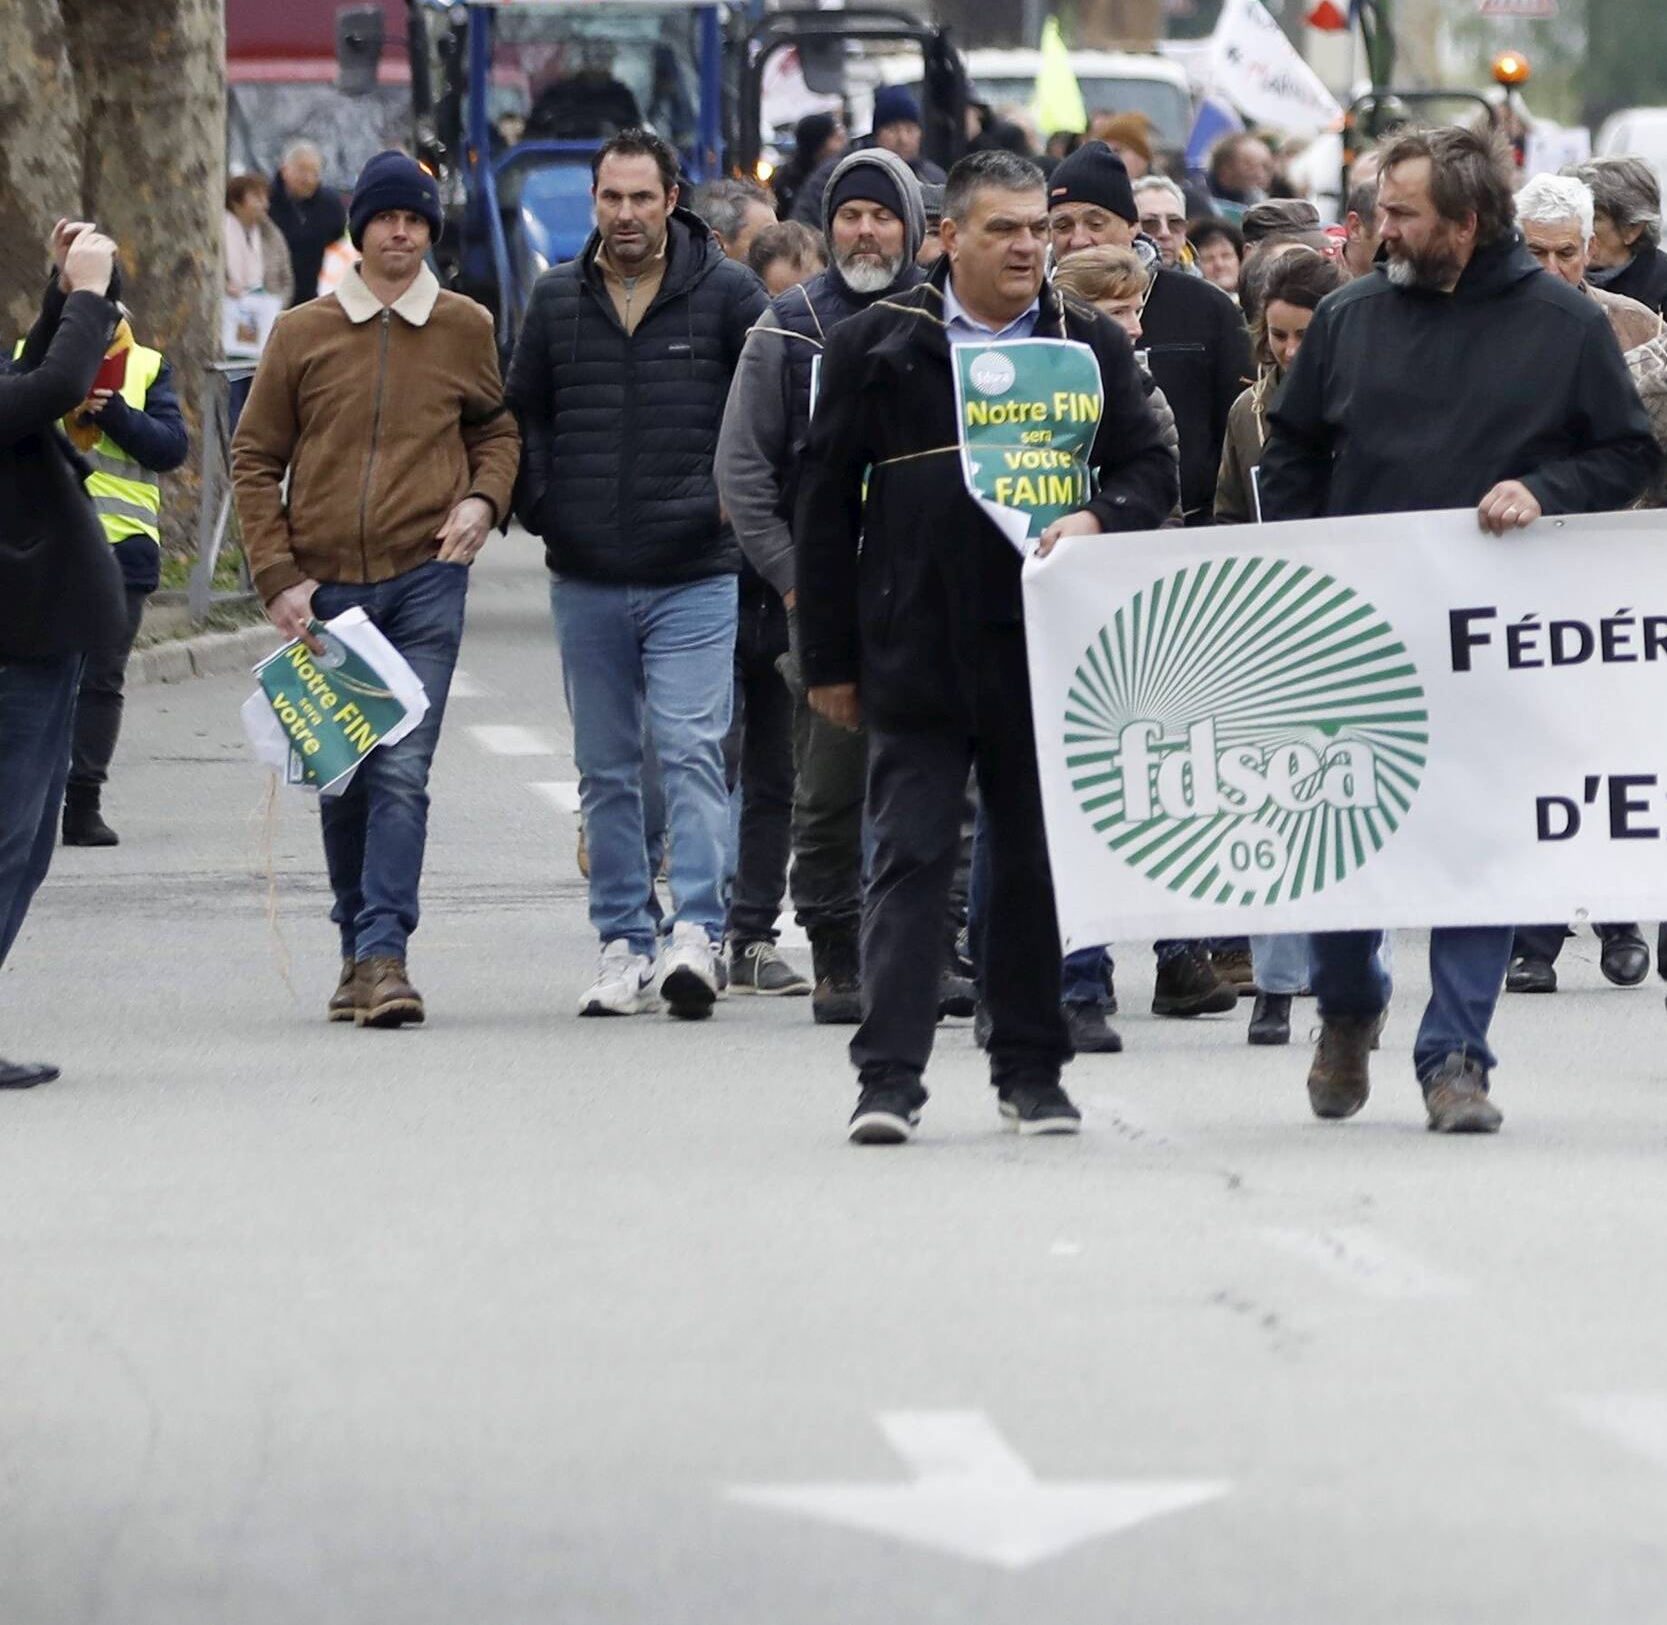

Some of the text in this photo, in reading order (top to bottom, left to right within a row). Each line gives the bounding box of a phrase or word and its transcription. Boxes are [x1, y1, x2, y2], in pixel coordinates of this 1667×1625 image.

[966, 391, 1099, 426] Notre FIN
[1003, 449, 1073, 471] votre
[272, 690, 321, 756] votre
[284, 641, 379, 755] Notre FIN
[1111, 714, 1381, 824] fdsea
[1229, 839, 1277, 873] 06
